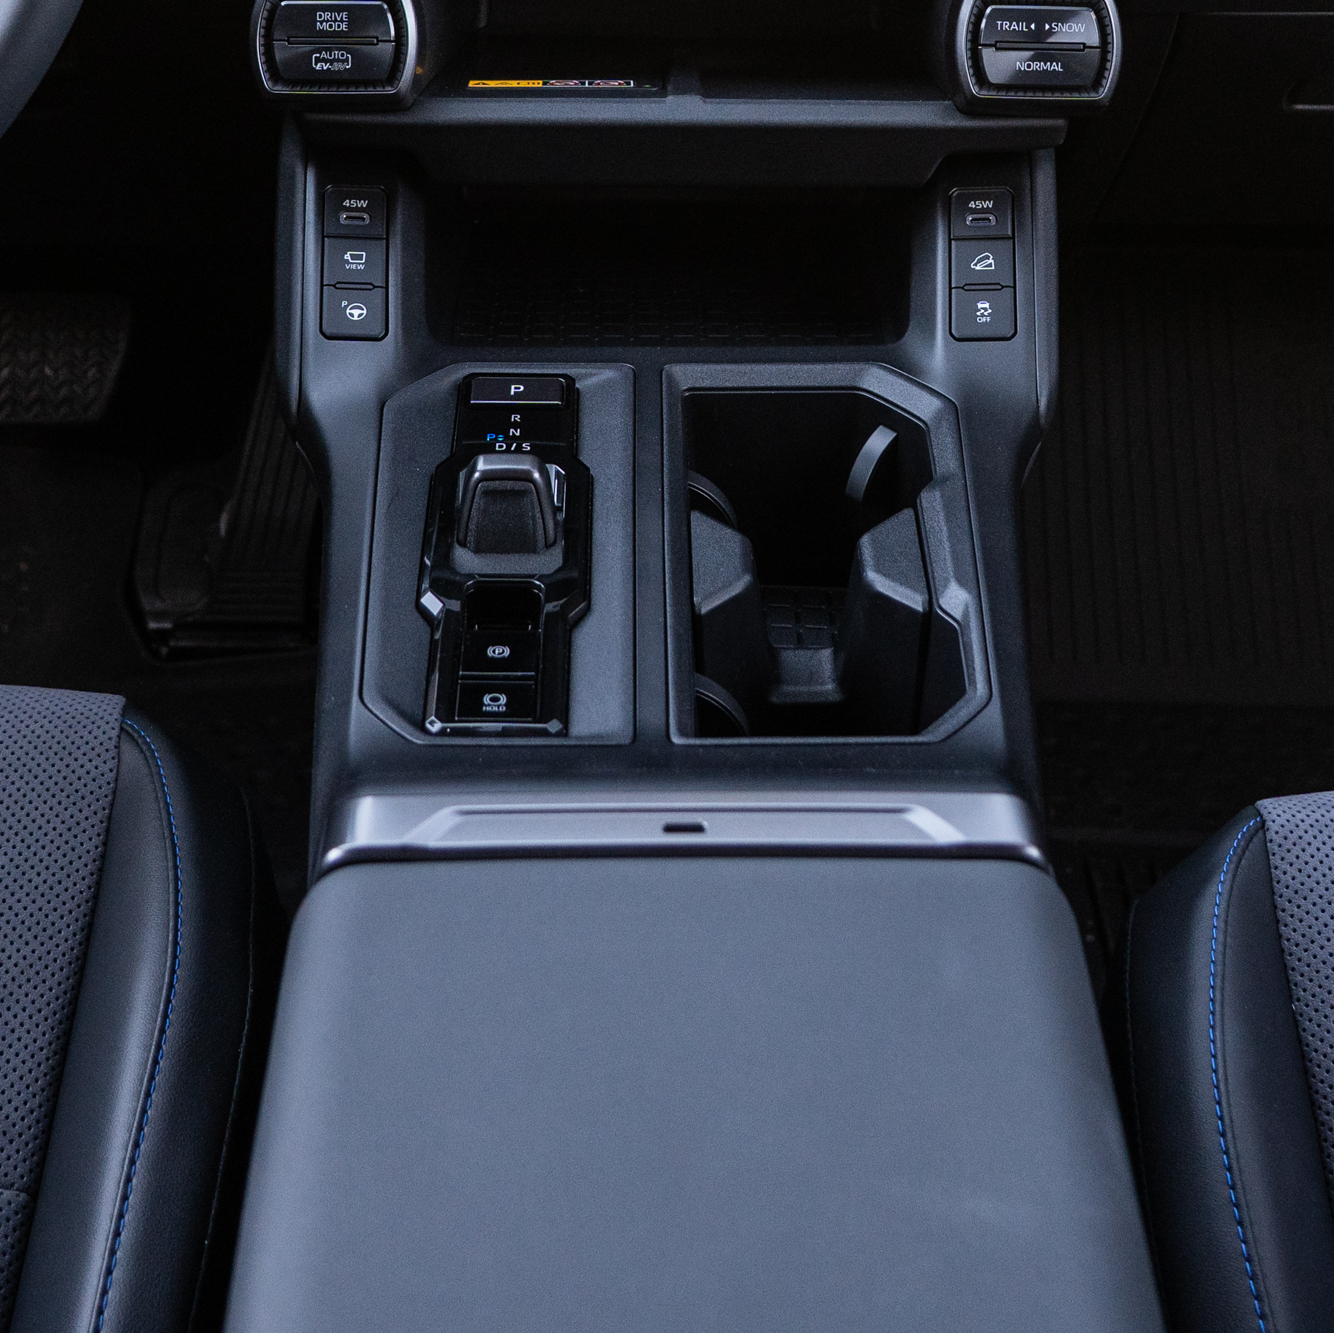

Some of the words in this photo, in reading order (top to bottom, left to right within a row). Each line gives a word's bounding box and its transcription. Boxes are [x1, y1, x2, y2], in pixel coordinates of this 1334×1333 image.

[316, 11, 349, 22] DRIVE
[316, 21, 349, 32] MODE
[996, 20, 1028, 31] TRAIL
[1051, 22, 1085, 33] SNOW
[320, 50, 347, 60] AUTO
[1016, 61, 1063, 72] NORMAL
[342, 199, 369, 208] 45W
[968, 200, 994, 209] 45W
[341, 300, 348, 308] P
[510, 384, 524, 395] P
[511, 413, 521, 422] R
[486, 433, 496, 441] P
[509, 428, 520, 436] N
